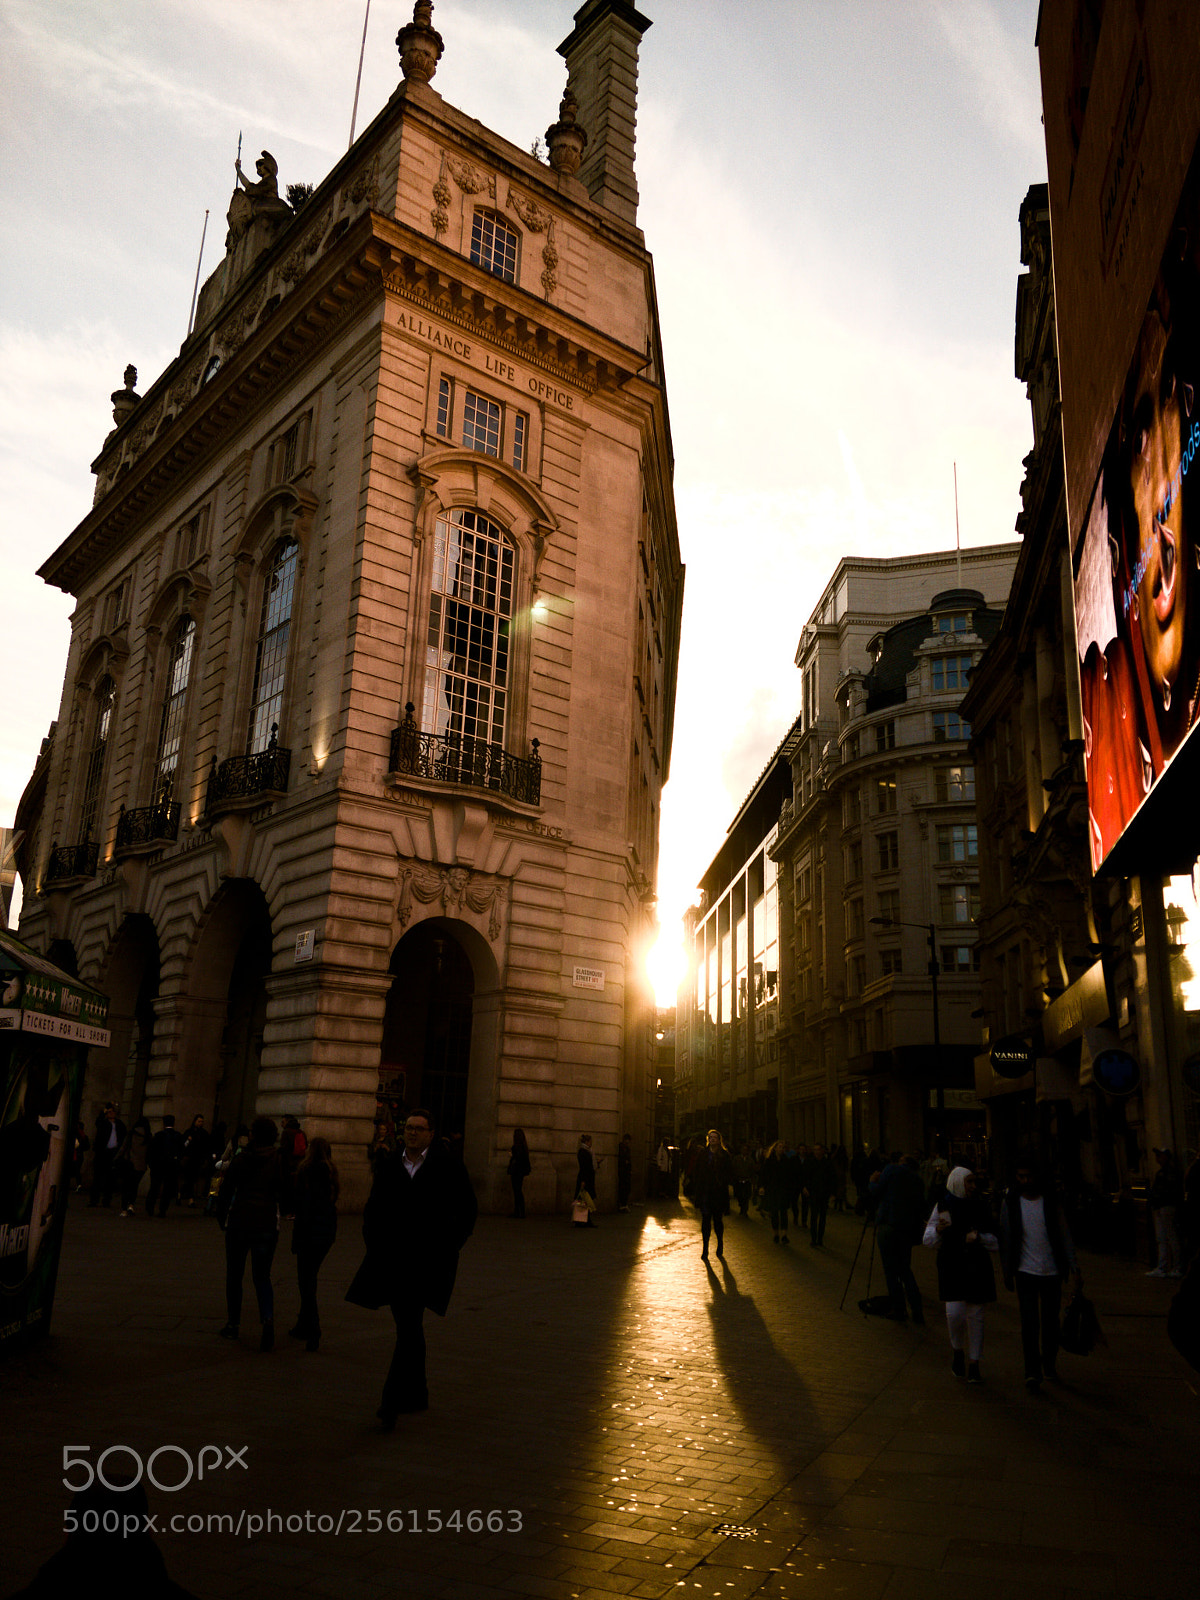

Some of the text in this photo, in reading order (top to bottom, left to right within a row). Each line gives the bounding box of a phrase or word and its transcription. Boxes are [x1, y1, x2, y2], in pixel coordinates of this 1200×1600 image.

[1105, 60, 1144, 236] HUNTER
[397, 312, 573, 410] ALLIANCE LIFE OFFICE
[1163, 421, 1200, 521] Harrods
[526, 820, 563, 839] OFFICE
[26, 1014, 55, 1032] TICKETS
[59, 1022, 72, 1036] FOR
[75, 1027, 86, 1039] ALL
[89, 1030, 108, 1043] SHOWS
[994, 1051, 1028, 1060] VANINI
